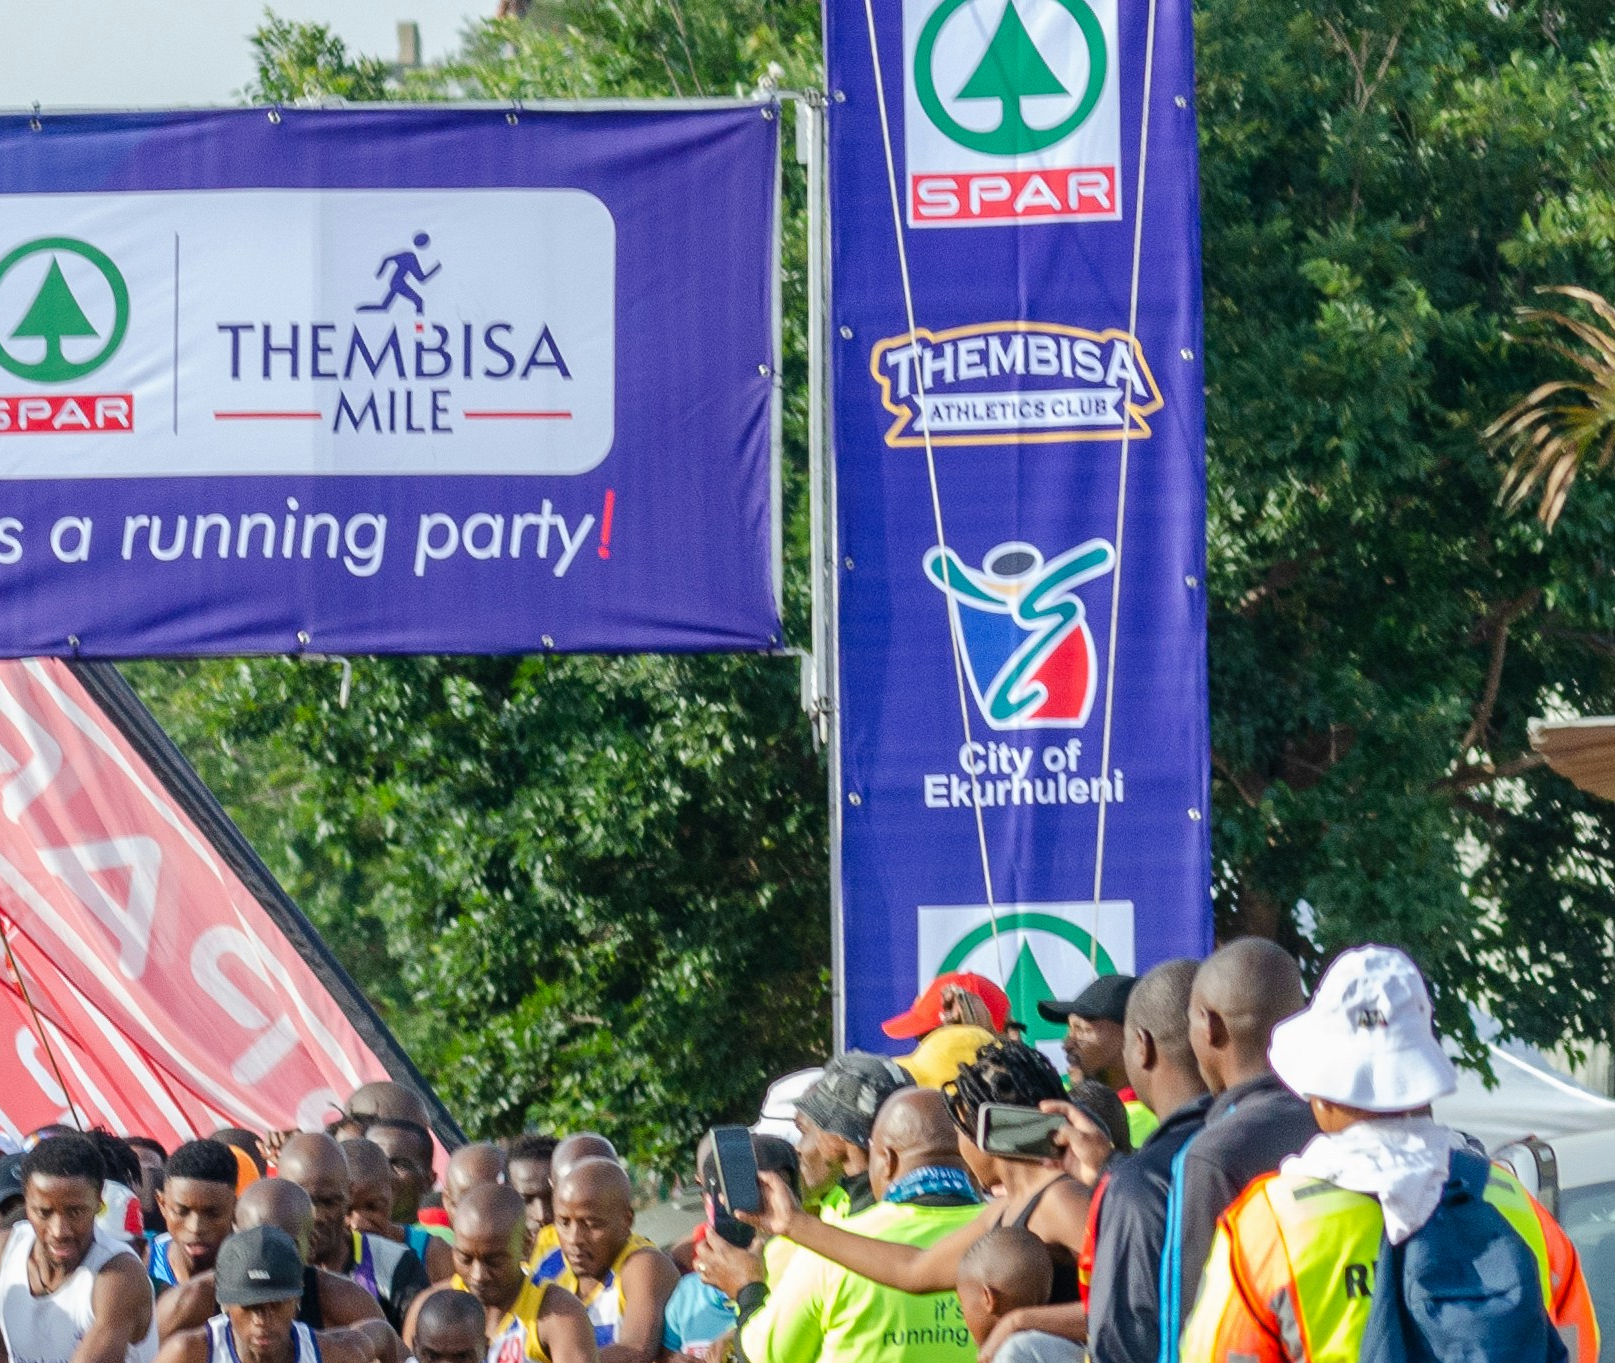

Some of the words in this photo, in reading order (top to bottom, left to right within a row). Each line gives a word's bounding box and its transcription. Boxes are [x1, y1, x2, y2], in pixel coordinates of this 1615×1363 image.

[917, 170, 1114, 217] SPAR
[216, 322, 573, 381] THEMBISA
[886, 335, 1149, 398] THEMBISA
[332, 390, 454, 434] MILE
[929, 400, 1047, 423] ATHLETICS
[1050, 397, 1109, 419] CLUB
[49, 515, 92, 562] a
[121, 496, 387, 577] running
[414, 488, 616, 577] party!
[959, 740, 1033, 778] City
[1042, 736, 1082, 772] of
[924, 768, 1125, 808] Ekurhuleni
[884, 1324, 969, 1347] running
